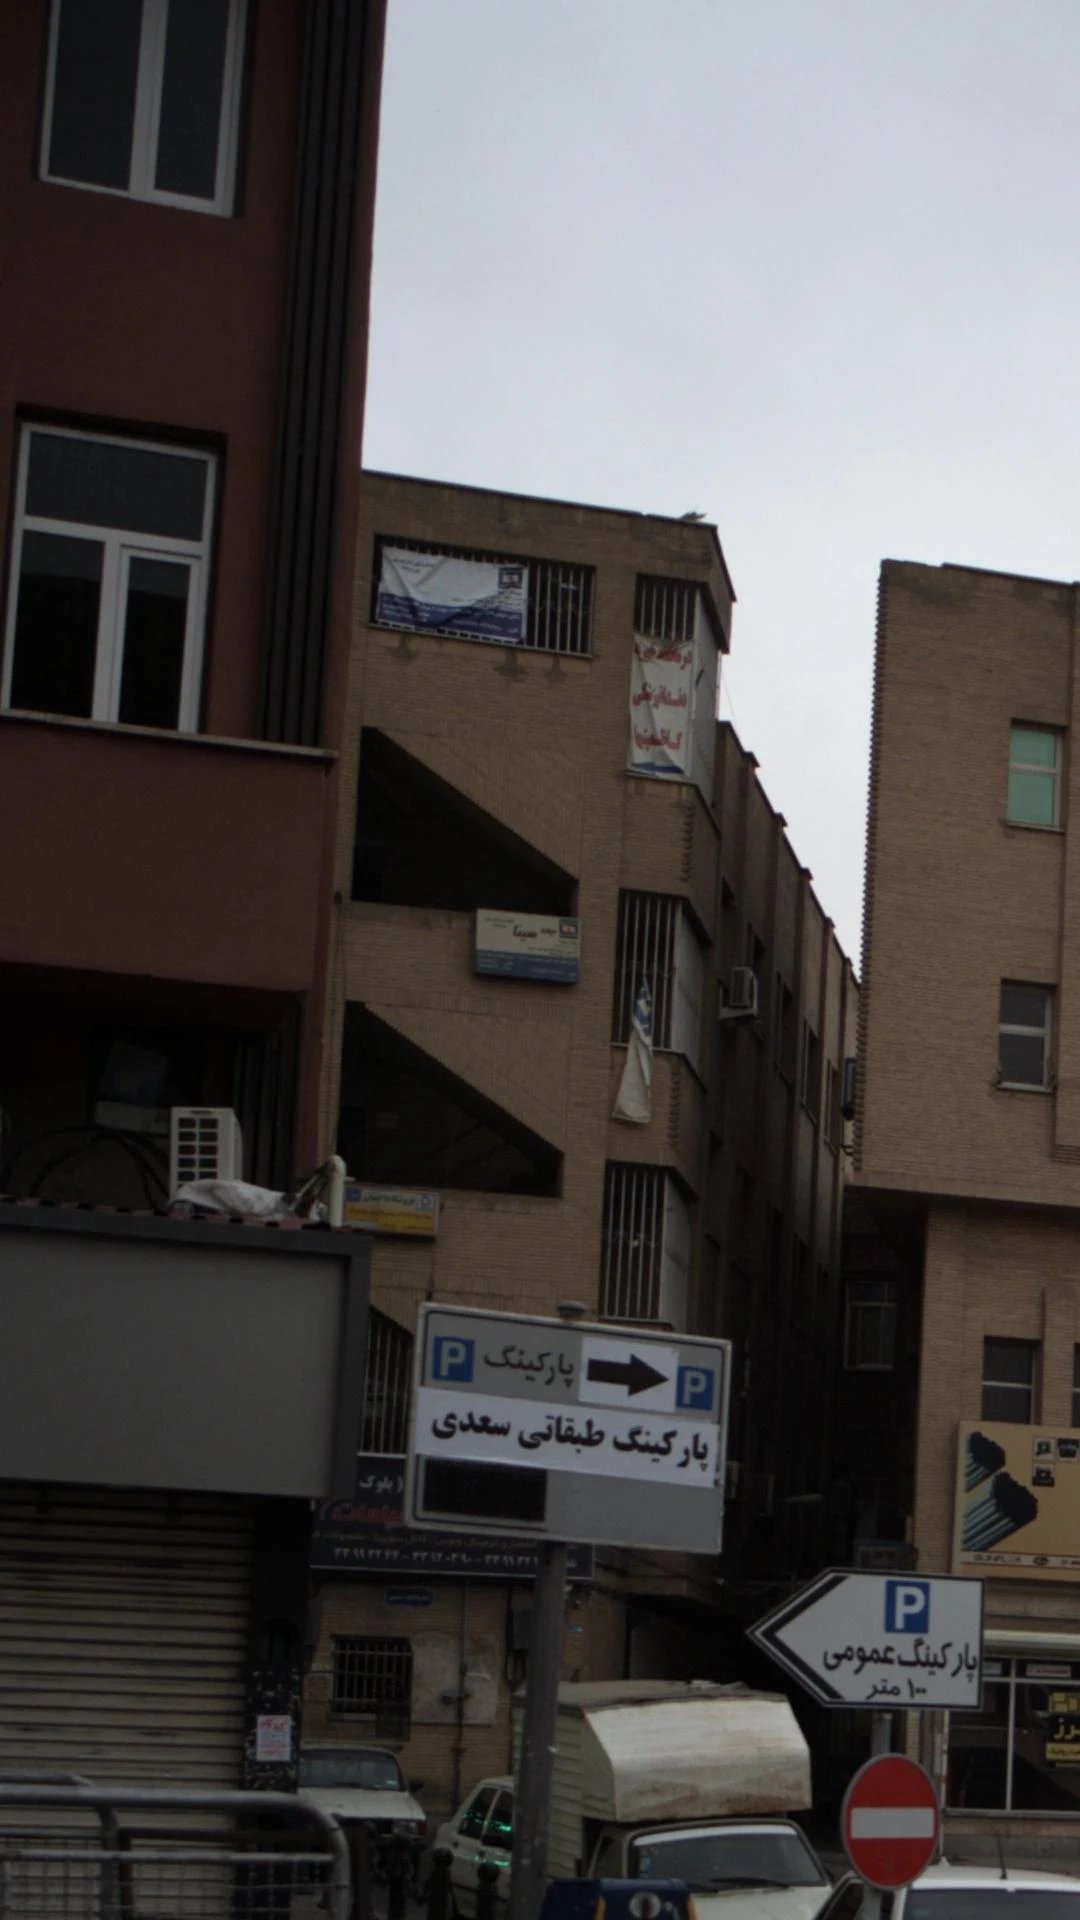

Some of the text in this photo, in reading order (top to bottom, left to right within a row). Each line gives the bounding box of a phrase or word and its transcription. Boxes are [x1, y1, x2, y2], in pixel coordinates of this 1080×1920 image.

[441, 1342, 466, 1376] P
[483, 1344, 574, 1389] پارکینگ
[683, 1372, 705, 1404] P
[432, 1409, 708, 1472] پارکینگ طبقاتی سعدی
[895, 1586, 925, 1630] P
[823, 1637, 977, 1683] پارکینگ عمومی
[866, 1678, 927, 1699] ۱۰۰ متر
